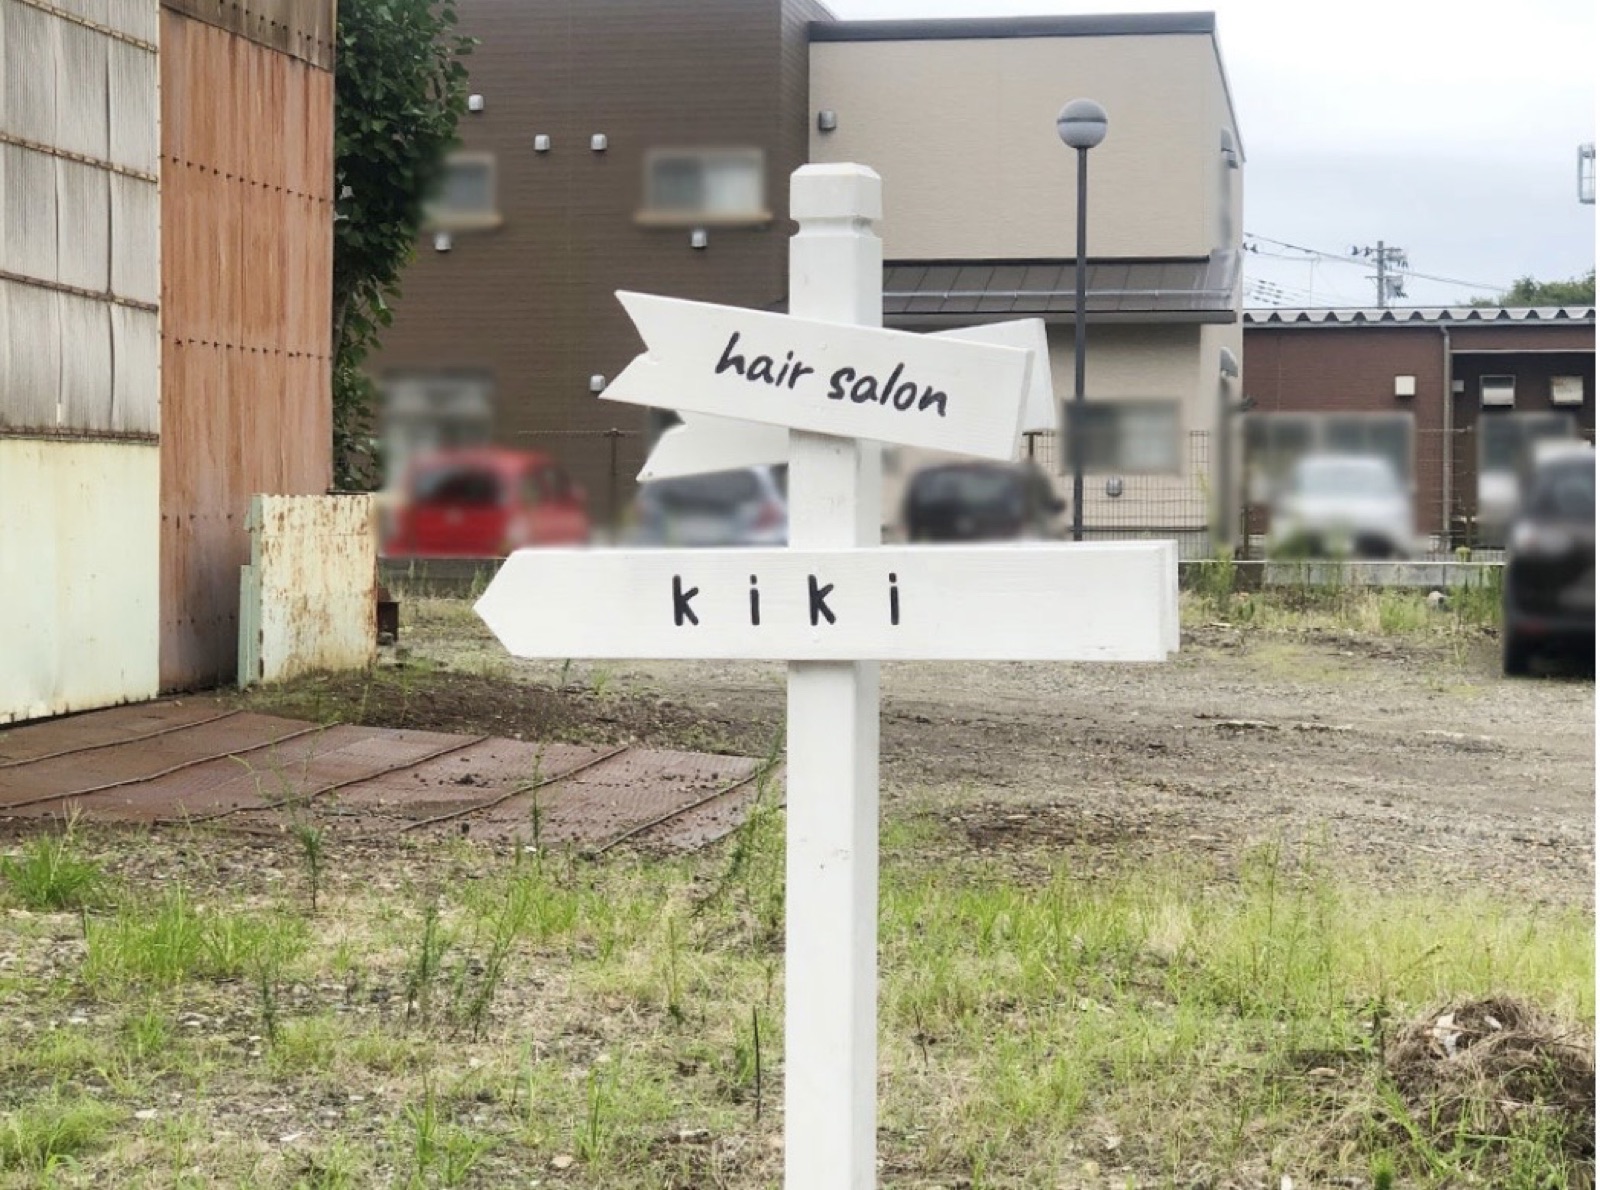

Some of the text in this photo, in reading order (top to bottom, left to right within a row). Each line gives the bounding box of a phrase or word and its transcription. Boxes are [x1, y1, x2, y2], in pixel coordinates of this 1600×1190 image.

[715, 332, 948, 418] hair salon
[672, 572, 900, 627] kiki
